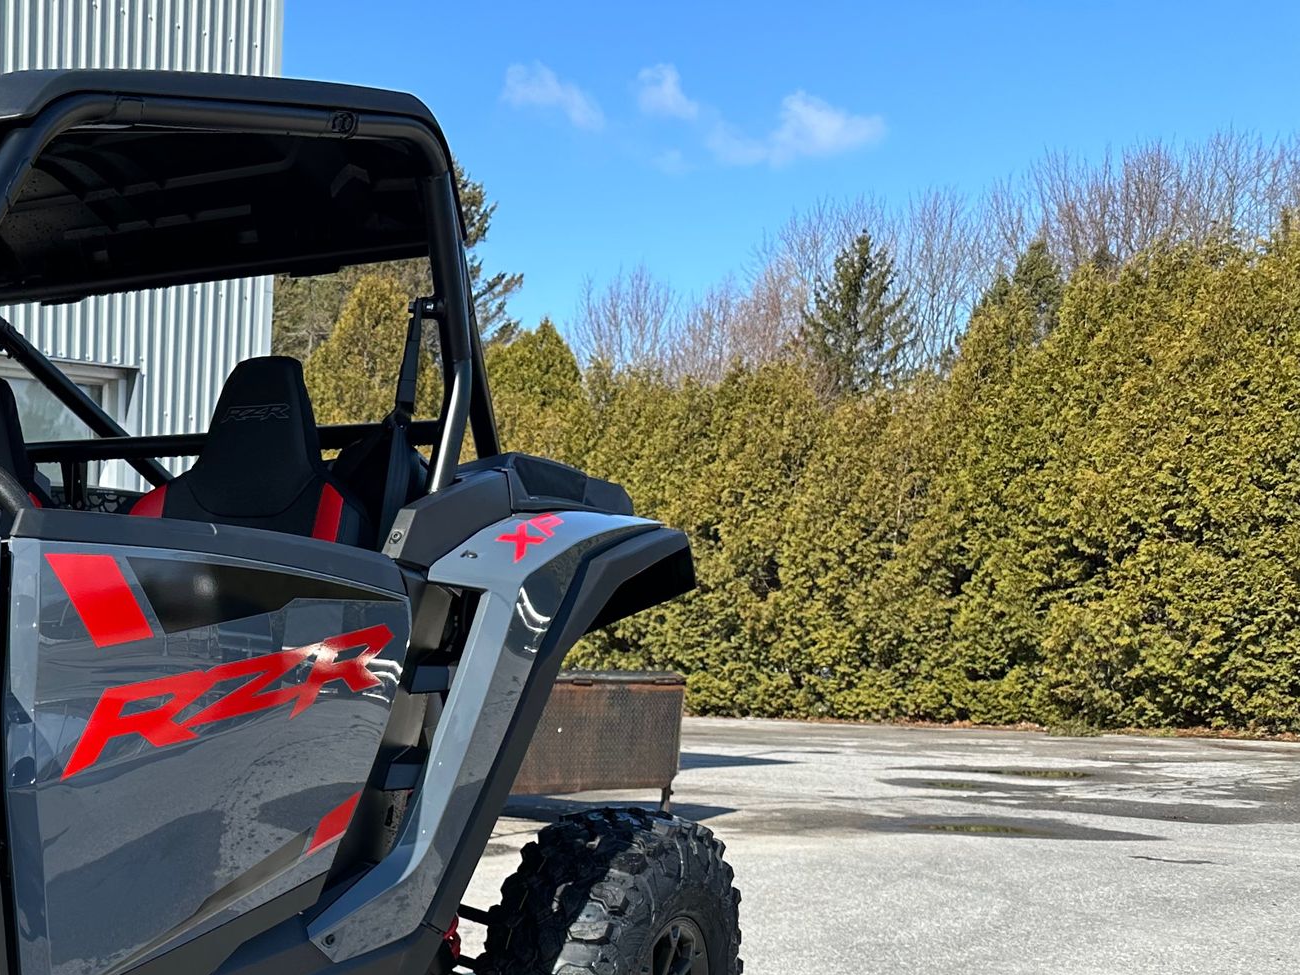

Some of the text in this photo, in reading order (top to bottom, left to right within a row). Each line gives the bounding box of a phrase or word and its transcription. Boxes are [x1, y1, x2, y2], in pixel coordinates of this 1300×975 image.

[220, 403, 290, 424] RZR
[494, 513, 565, 564] XP
[59, 622, 396, 782] RZR
